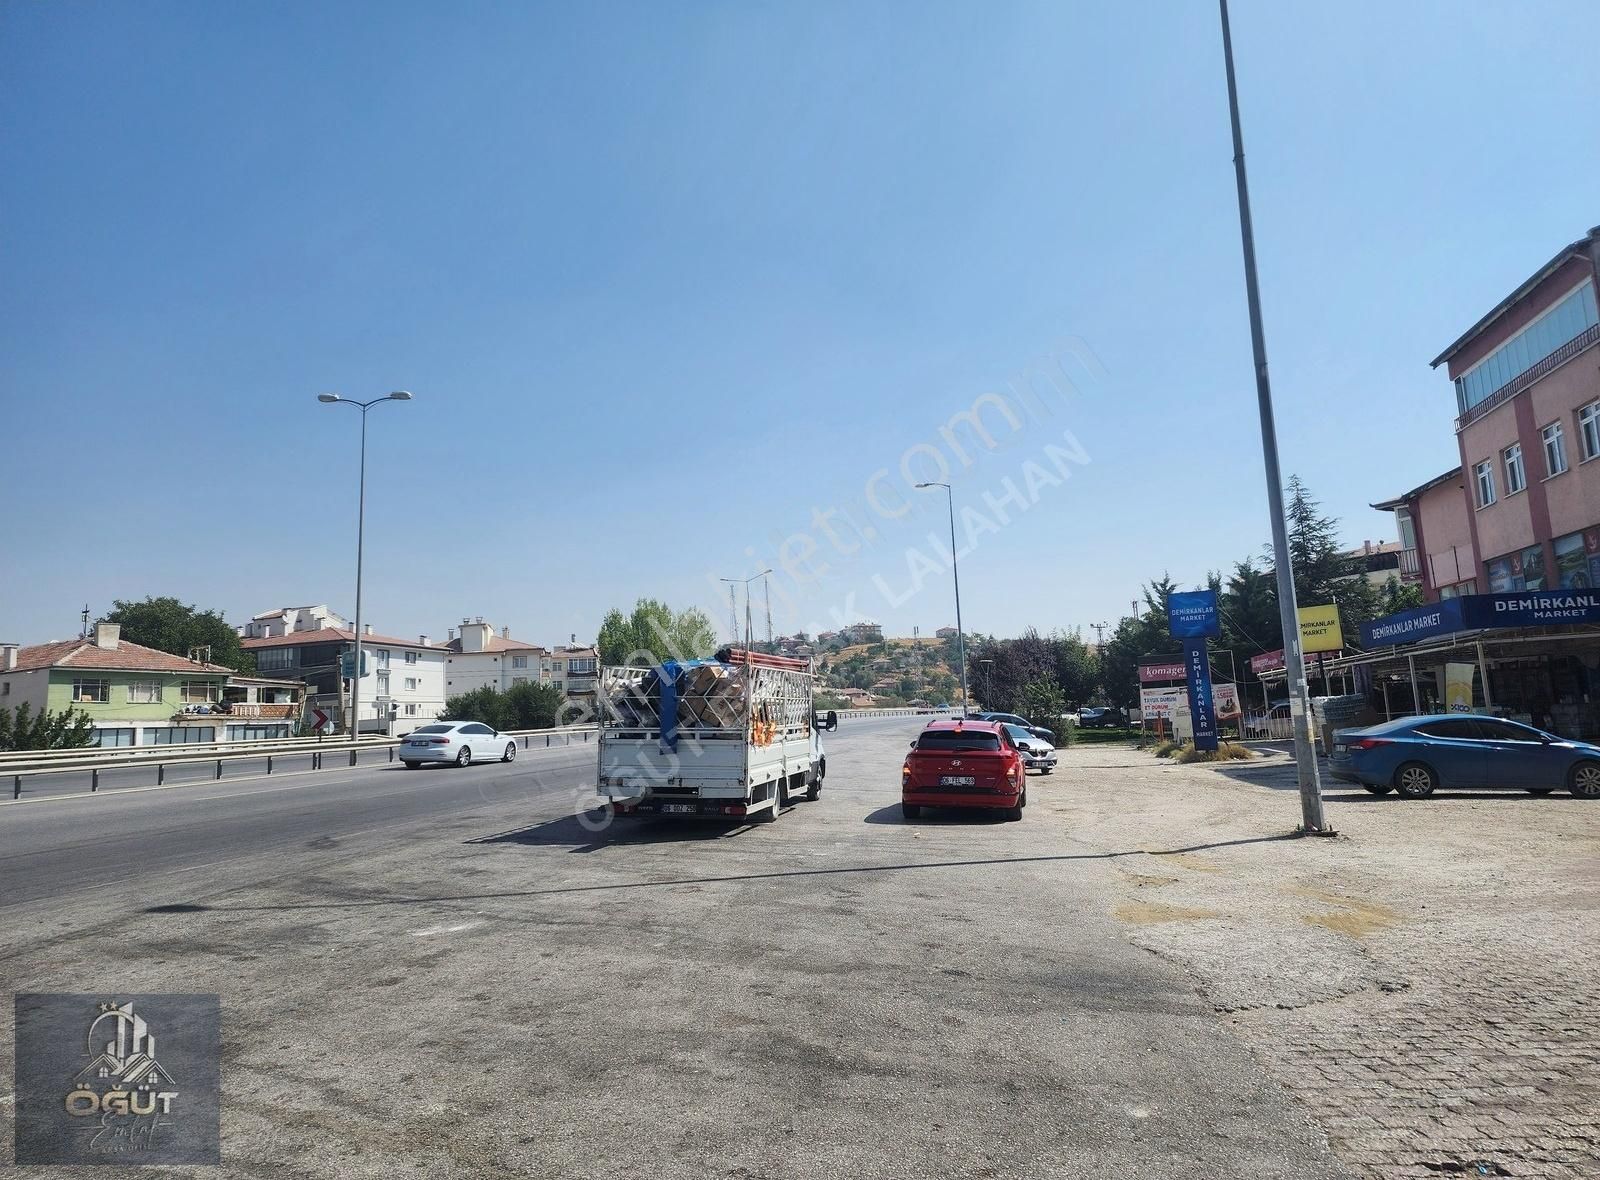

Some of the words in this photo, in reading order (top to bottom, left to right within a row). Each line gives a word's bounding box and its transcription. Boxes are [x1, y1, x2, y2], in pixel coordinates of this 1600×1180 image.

[1171, 606, 1214, 616] DEMİRKANLAR
[1534, 608, 1587, 618] MARKET
[1180, 614, 1206, 622] MARKET
[1372, 618, 1413, 639] DEMİRKANLAR
[1413, 612, 1441, 630] MARKET
